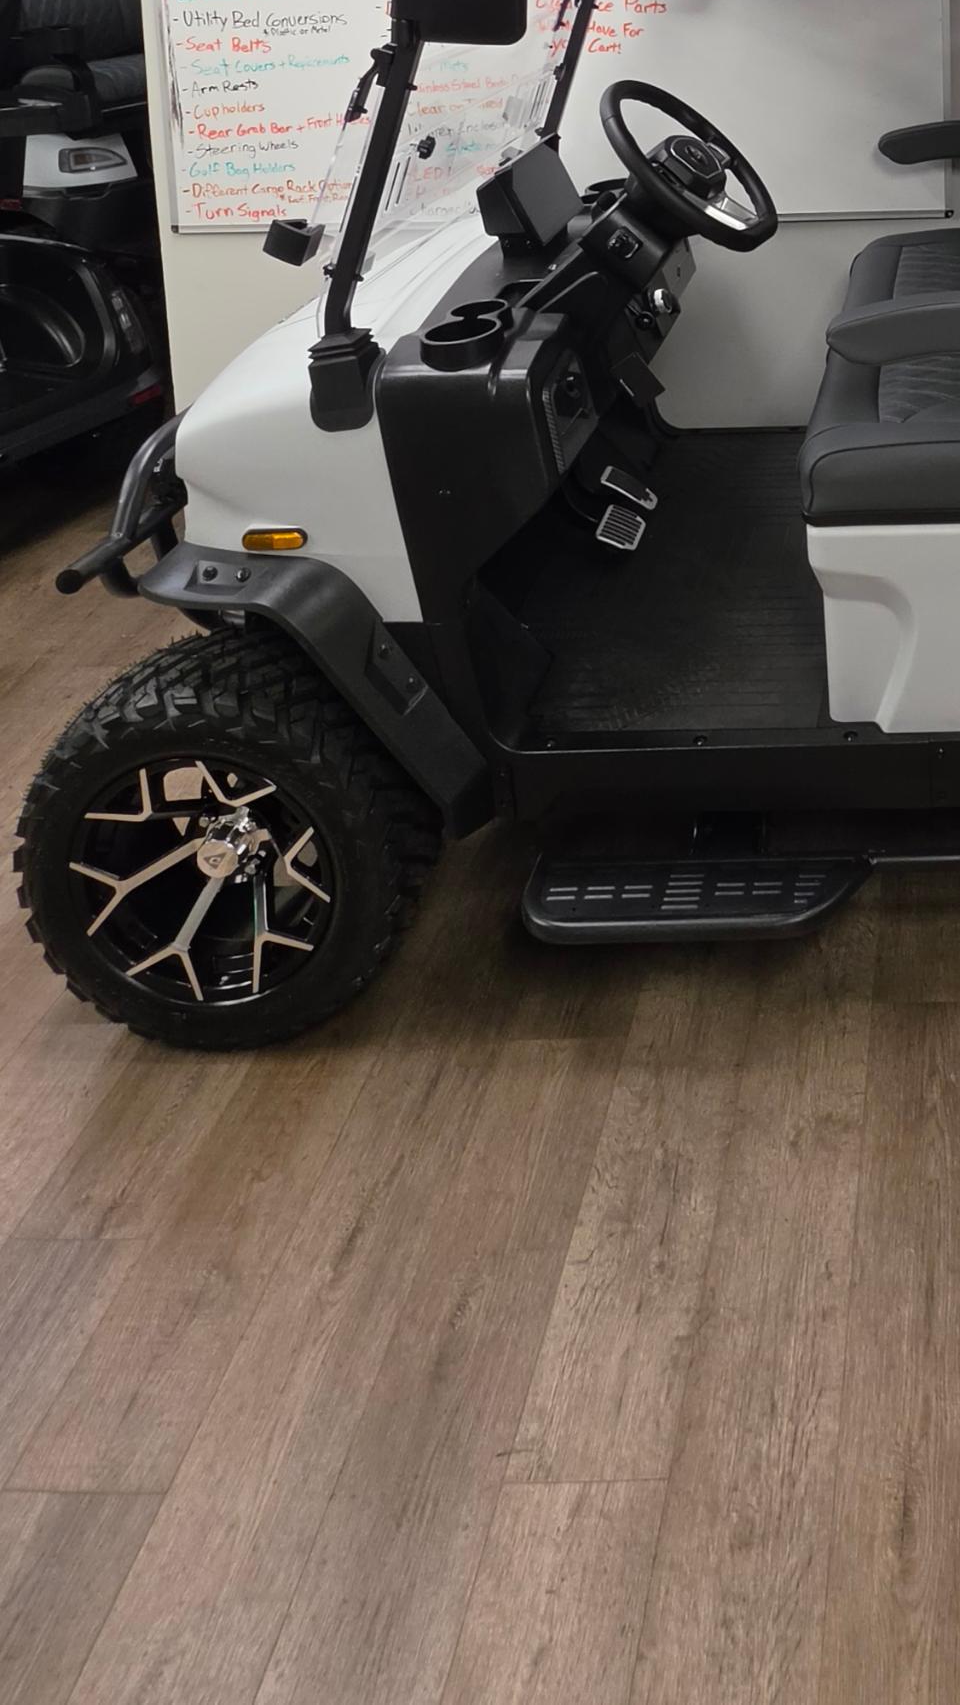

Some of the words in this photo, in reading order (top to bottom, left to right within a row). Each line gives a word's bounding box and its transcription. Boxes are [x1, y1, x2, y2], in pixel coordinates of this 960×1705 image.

[183, 10, 228, 32] Utility
[232, 10, 260, 29] Bed
[265, 11, 348, 28] Conversions
[623, 22, 644, 38] For
[185, 36, 223, 52] Seat
[231, 37, 272, 54] Belts
[588, 38, 622, 54] Cart!
[191, 58, 229, 77] Seat
[234, 60, 275, 74] Covers
[191, 80, 220, 98] Arm
[223, 78, 259, 92] Rests
[196, 123, 232, 140] Rear
[236, 123, 266, 137] Grab
[270, 122, 292, 135] Bar
[194, 143, 257, 159] Steering
[258, 139, 299, 152] Wheels
[189, 163, 220, 178] Golf
[225, 162, 250, 177] Bag
[253, 161, 296, 173] Holders
[192, 182, 248, 199] Different
[251, 182, 284, 199] Cargo
[286, 179, 316, 194] Rack
[193, 202, 234, 220] Turn
[237, 201, 287, 221] Signals
